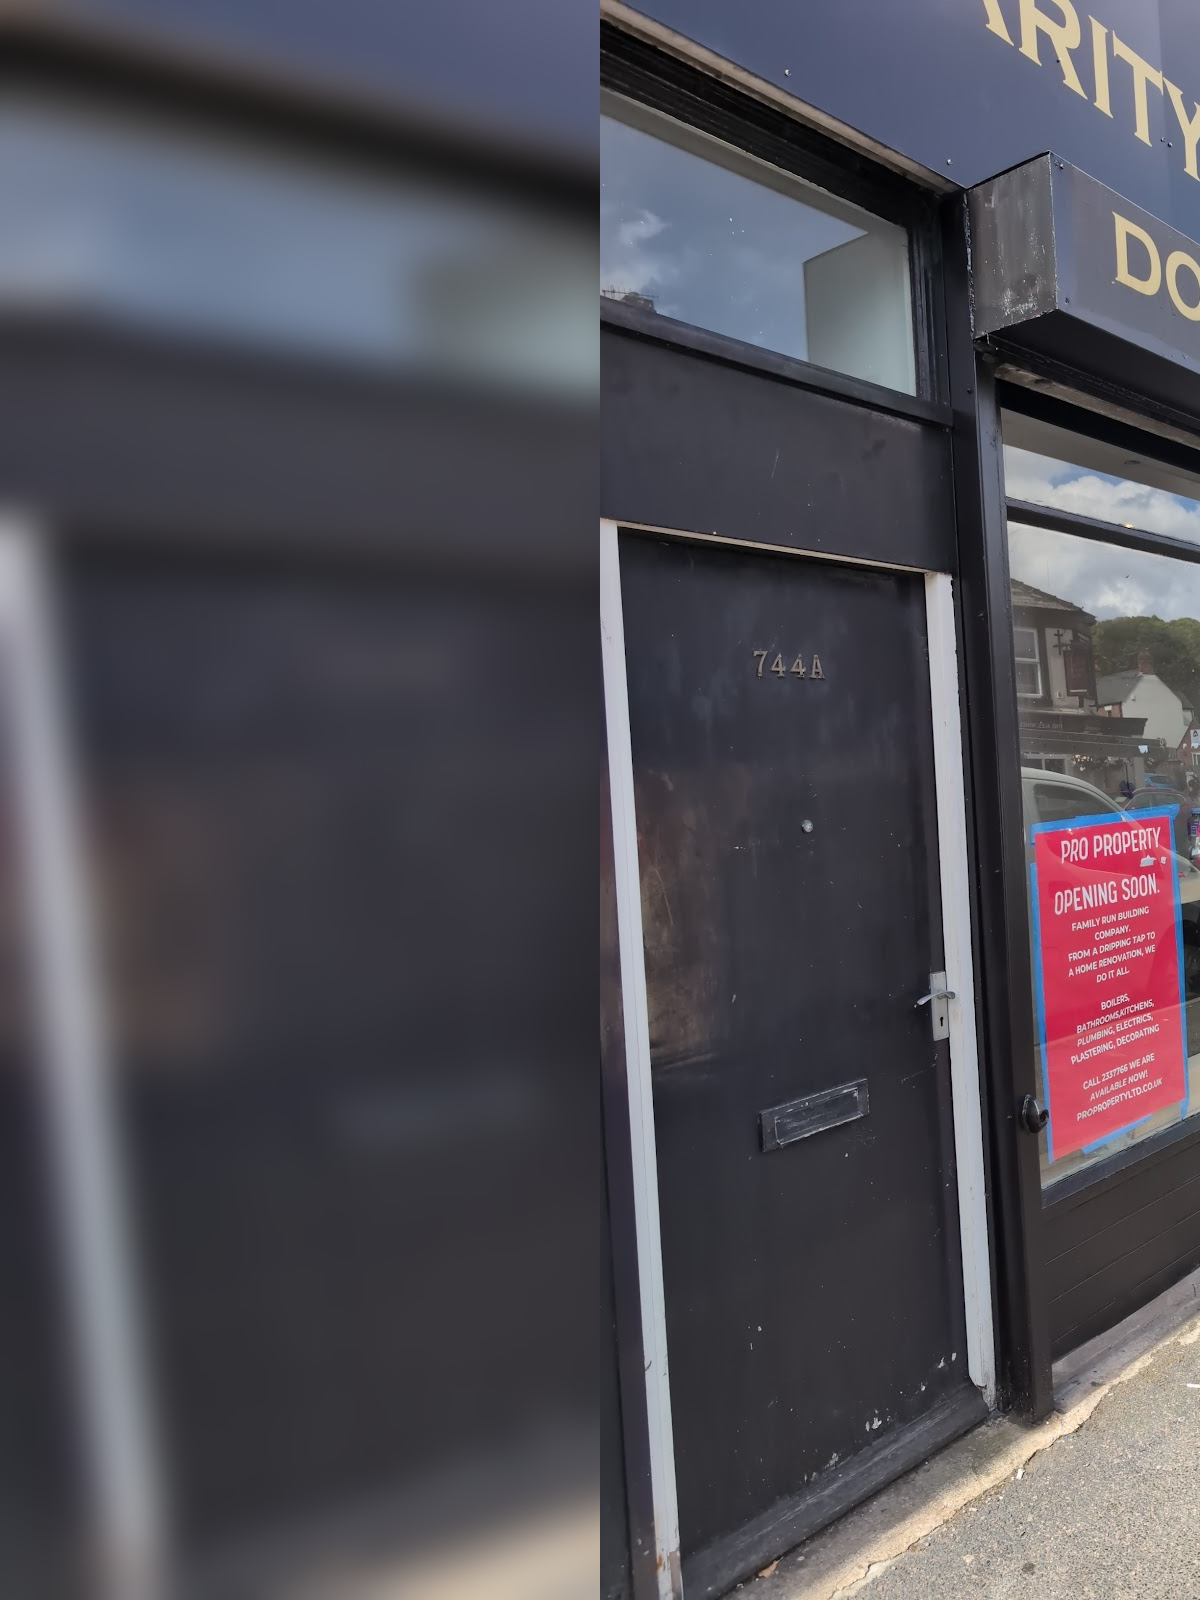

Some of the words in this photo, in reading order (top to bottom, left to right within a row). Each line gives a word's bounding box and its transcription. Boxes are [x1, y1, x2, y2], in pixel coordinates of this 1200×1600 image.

[753, 650, 826, 679] 744A
[1061, 837, 1089, 864] PRO
[1093, 827, 1161, 858] PROPERTY
[1054, 881, 1118, 915] OPENING
[1121, 873, 1160, 901] SOON.
[1071, 917, 1101, 932] FAMILY
[1101, 914, 1117, 924] RUN
[1118, 906, 1149, 921] BUILDING
[1094, 924, 1131, 941] COMPANY.
[1068, 949, 1090, 962] FROM
[1092, 947, 1098, 956] A
[1099, 938, 1131, 954] DRIPPING
[1132, 934, 1145, 944] TAP
[1147, 931, 1156, 940] TO
[1068, 968, 1074, 977] A
[1075, 961, 1098, 975] HOME
[1099, 948, 1144, 968] RENOVATION,
[1145, 944, 1156, 955] WE
[1096, 973, 1107, 983] DO
[1108, 969, 1115, 979] IT
[1101, 993, 1130, 1011] BOILERS,
[1070, 1041, 1116, 1065] PLASTERING,
[1116, 1024, 1160, 1047] DECORATING
[1077, 1026, 1115, 1047] PLUMBING,
[1116, 1012, 1154, 1032] ELECTRICS,
[1082, 1076, 1101, 1090] CALL
[1101, 1064, 1128, 1082] 2337766
[1129, 1058, 1141, 1070] WE
[1141, 1052, 1155, 1065] ARE
[1090, 1078, 1127, 1102] AVAILABLE
[1128, 1069, 1149, 1084] NOW!
[1076, 1077, 1163, 1121] PROPROPERTYLTD.CO.UK
